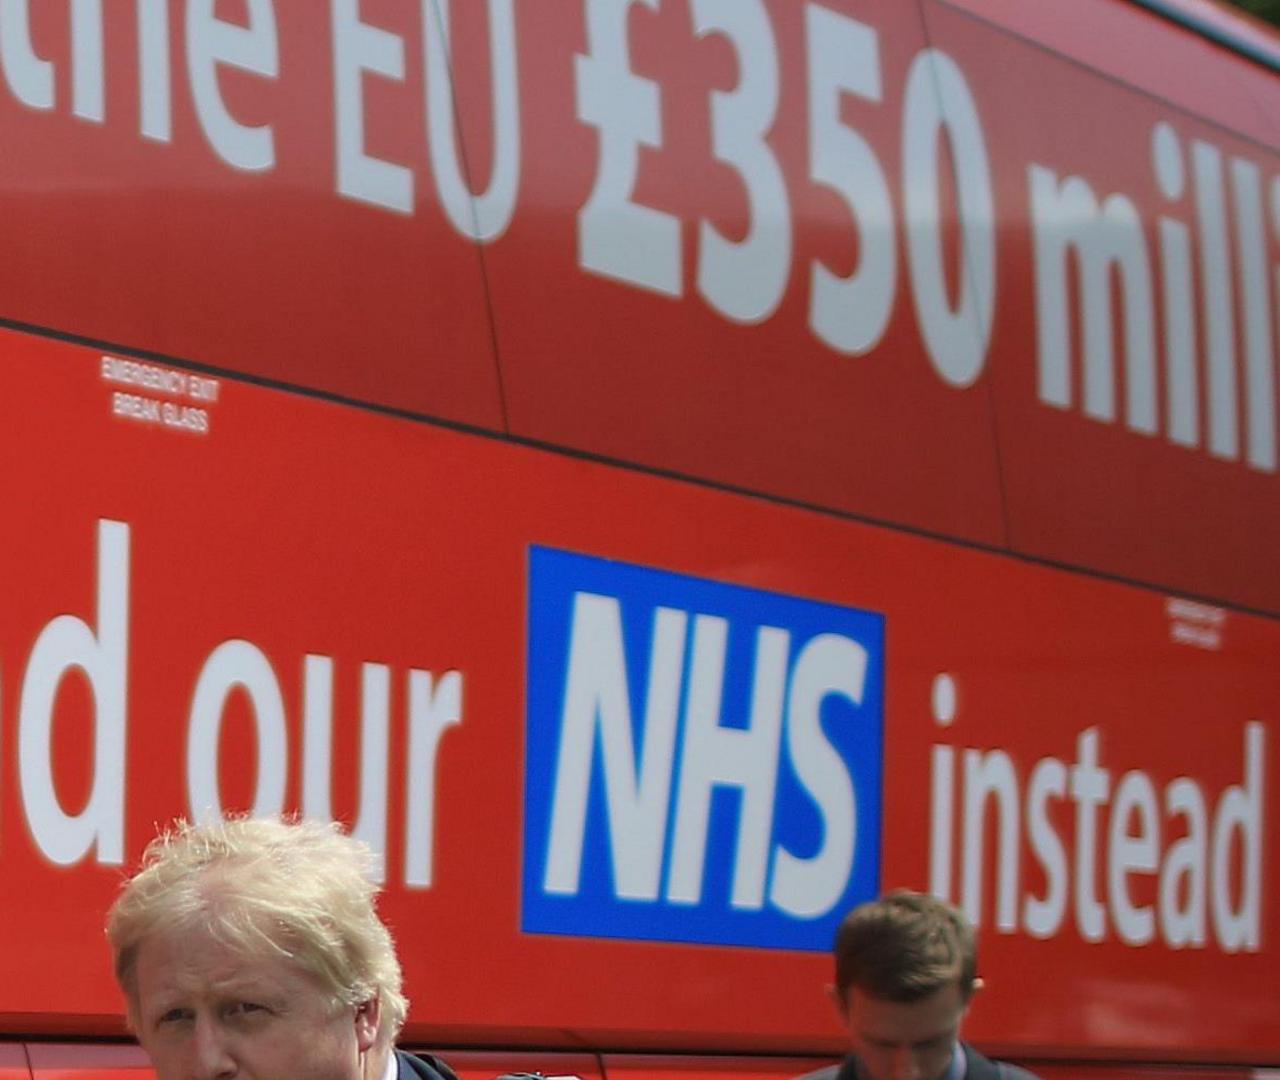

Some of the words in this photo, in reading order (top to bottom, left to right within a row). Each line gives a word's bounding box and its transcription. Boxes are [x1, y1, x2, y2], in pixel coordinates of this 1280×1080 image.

[573, 0, 996, 389] £350
[1027, 120, 1280, 474] mill
[101, 356, 186, 393] EMERGENCY
[113, 391, 160, 422] BREAK
[162, 402, 208, 434] GLASS
[186, 637, 462, 887] our
[544, 591, 868, 920] NHS
[931, 672, 1264, 953] instead
